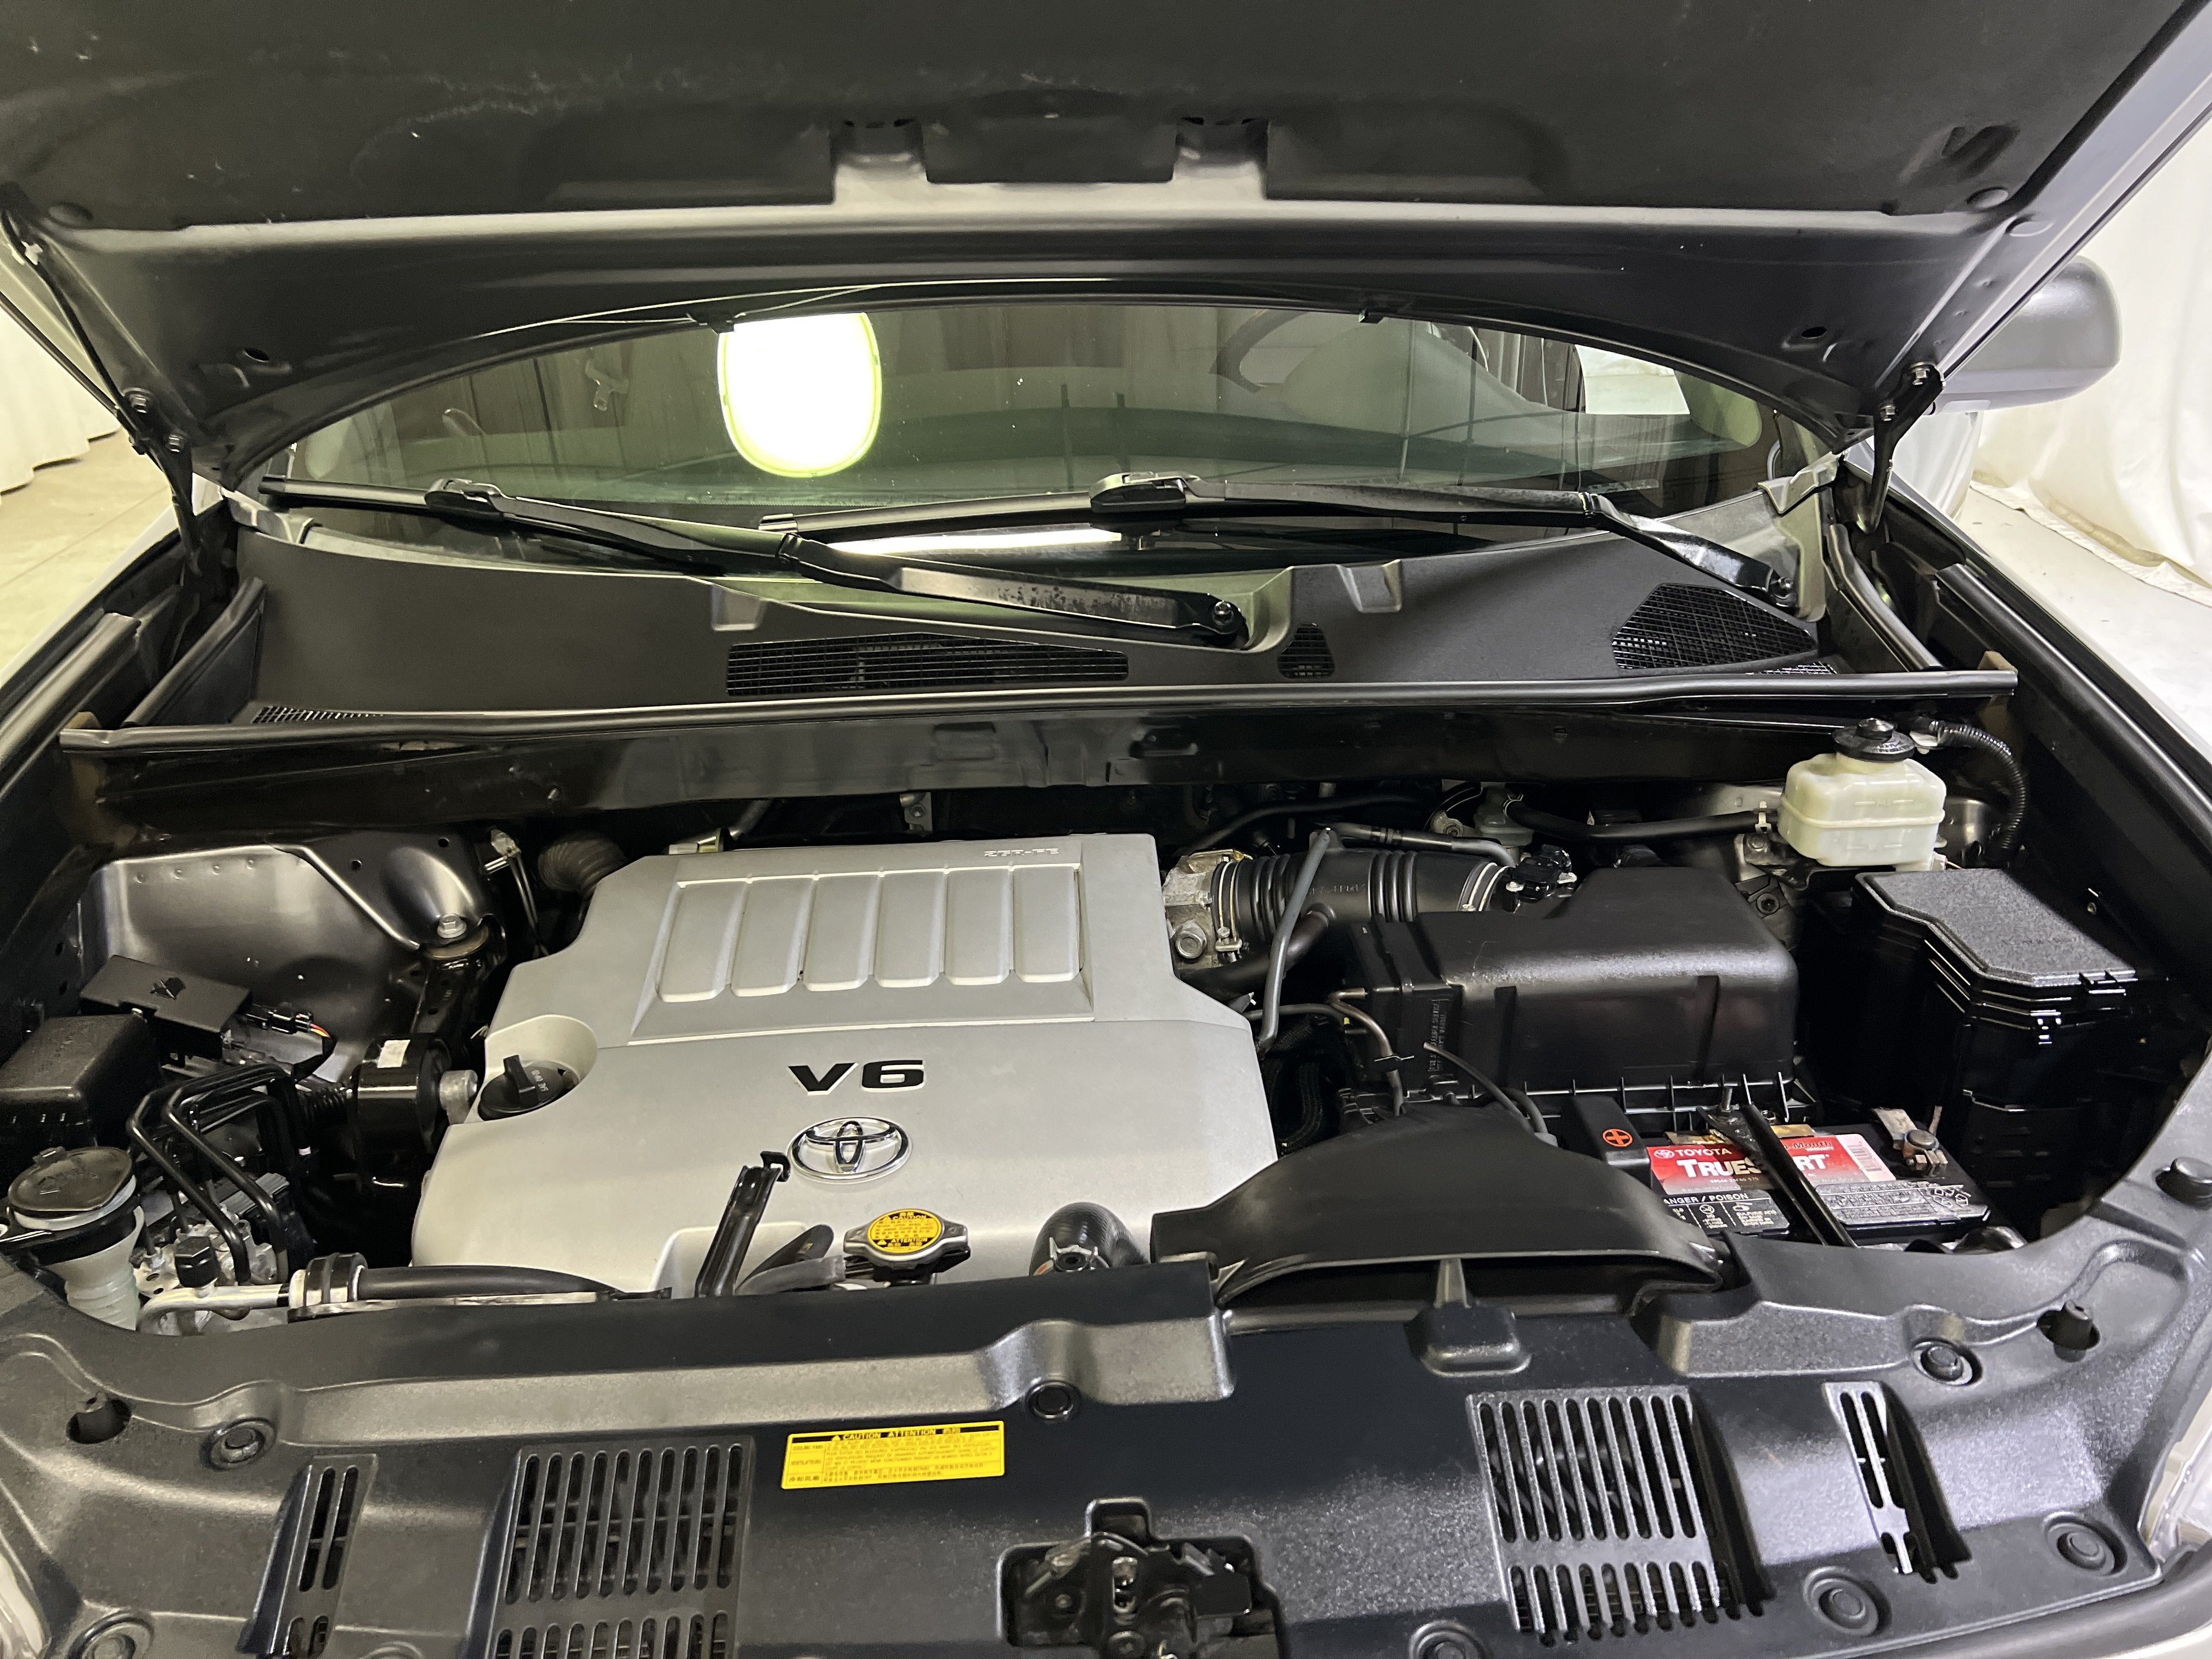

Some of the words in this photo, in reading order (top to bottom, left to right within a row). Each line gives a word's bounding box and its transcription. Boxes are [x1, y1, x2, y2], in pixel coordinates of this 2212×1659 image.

[788, 1059, 924, 1096] V6
[1675, 1148, 1732, 1157] TOYOTA
[1710, 1193, 1748, 1201] POISON
[843, 1432, 881, 1440] CAUTION
[887, 1429, 936, 1438] ATTENTION
